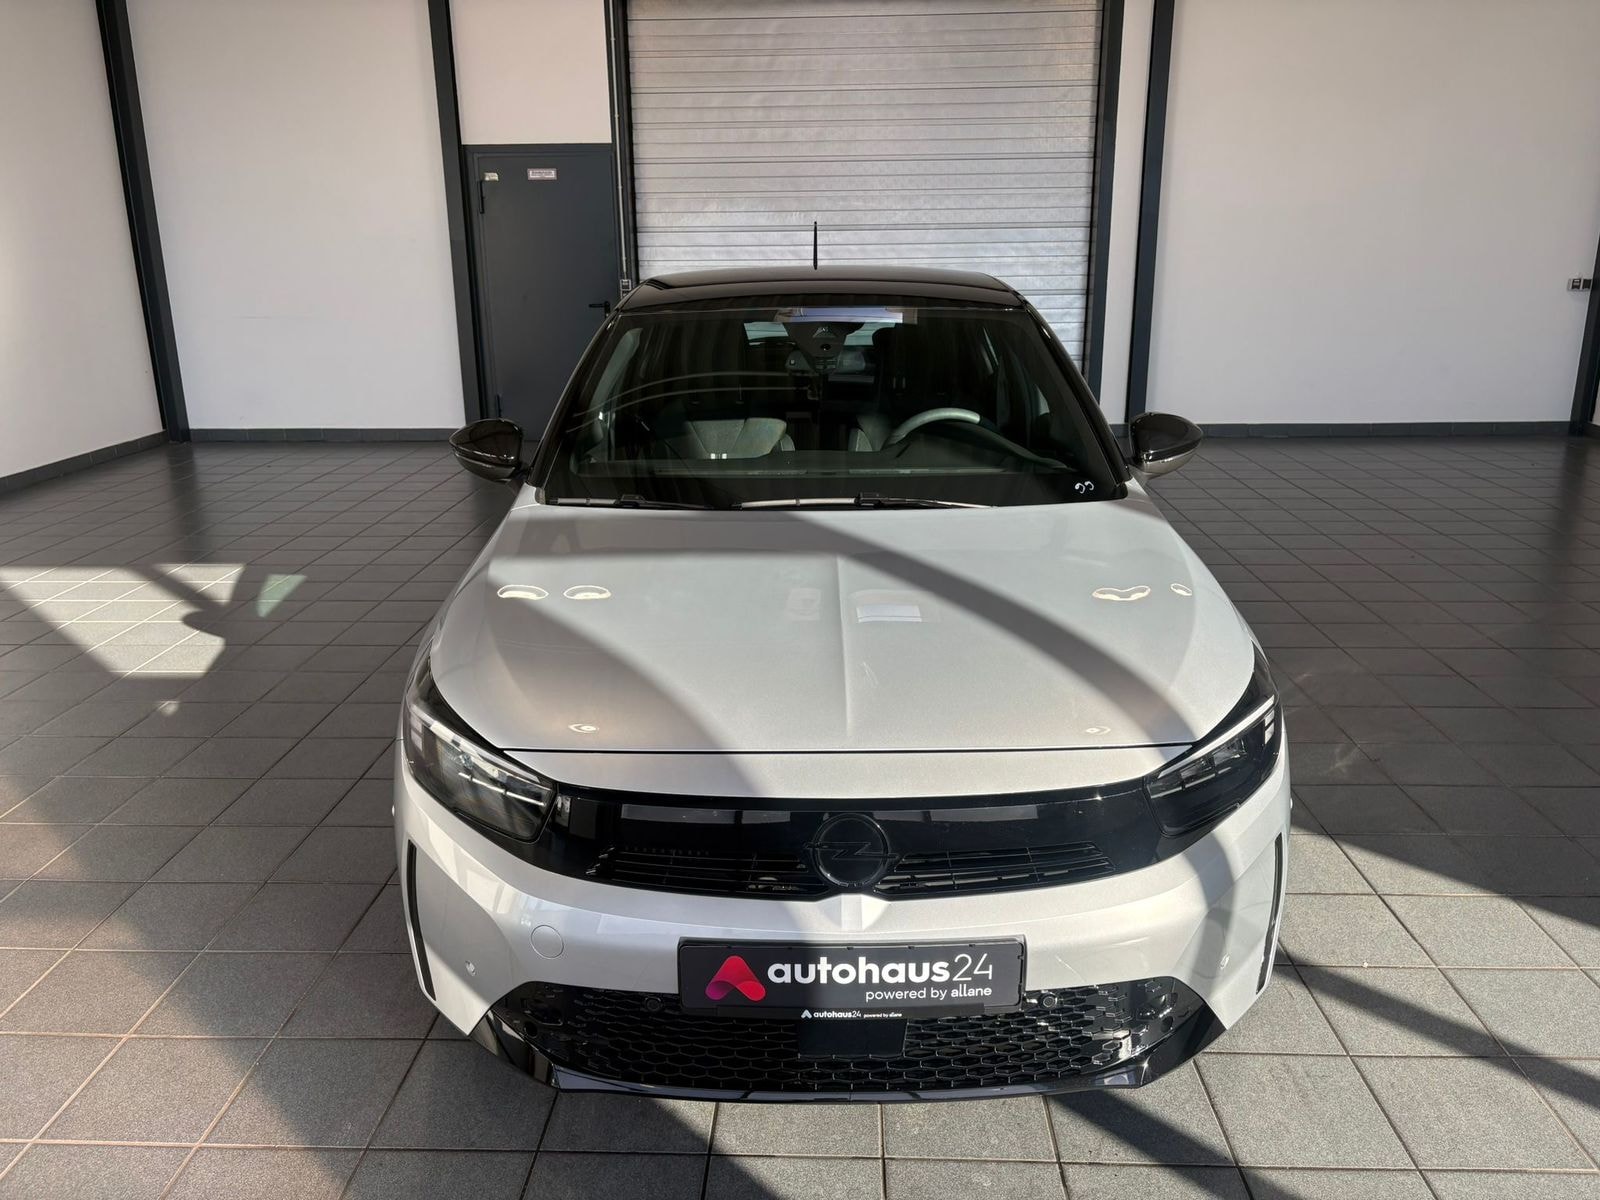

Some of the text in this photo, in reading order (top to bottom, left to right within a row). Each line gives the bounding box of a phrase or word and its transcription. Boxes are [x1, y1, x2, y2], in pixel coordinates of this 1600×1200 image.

[767, 953, 993, 985] autohaus24
[865, 983, 993, 1003] powered by allane
[813, 1010, 862, 1019] autohaus24
